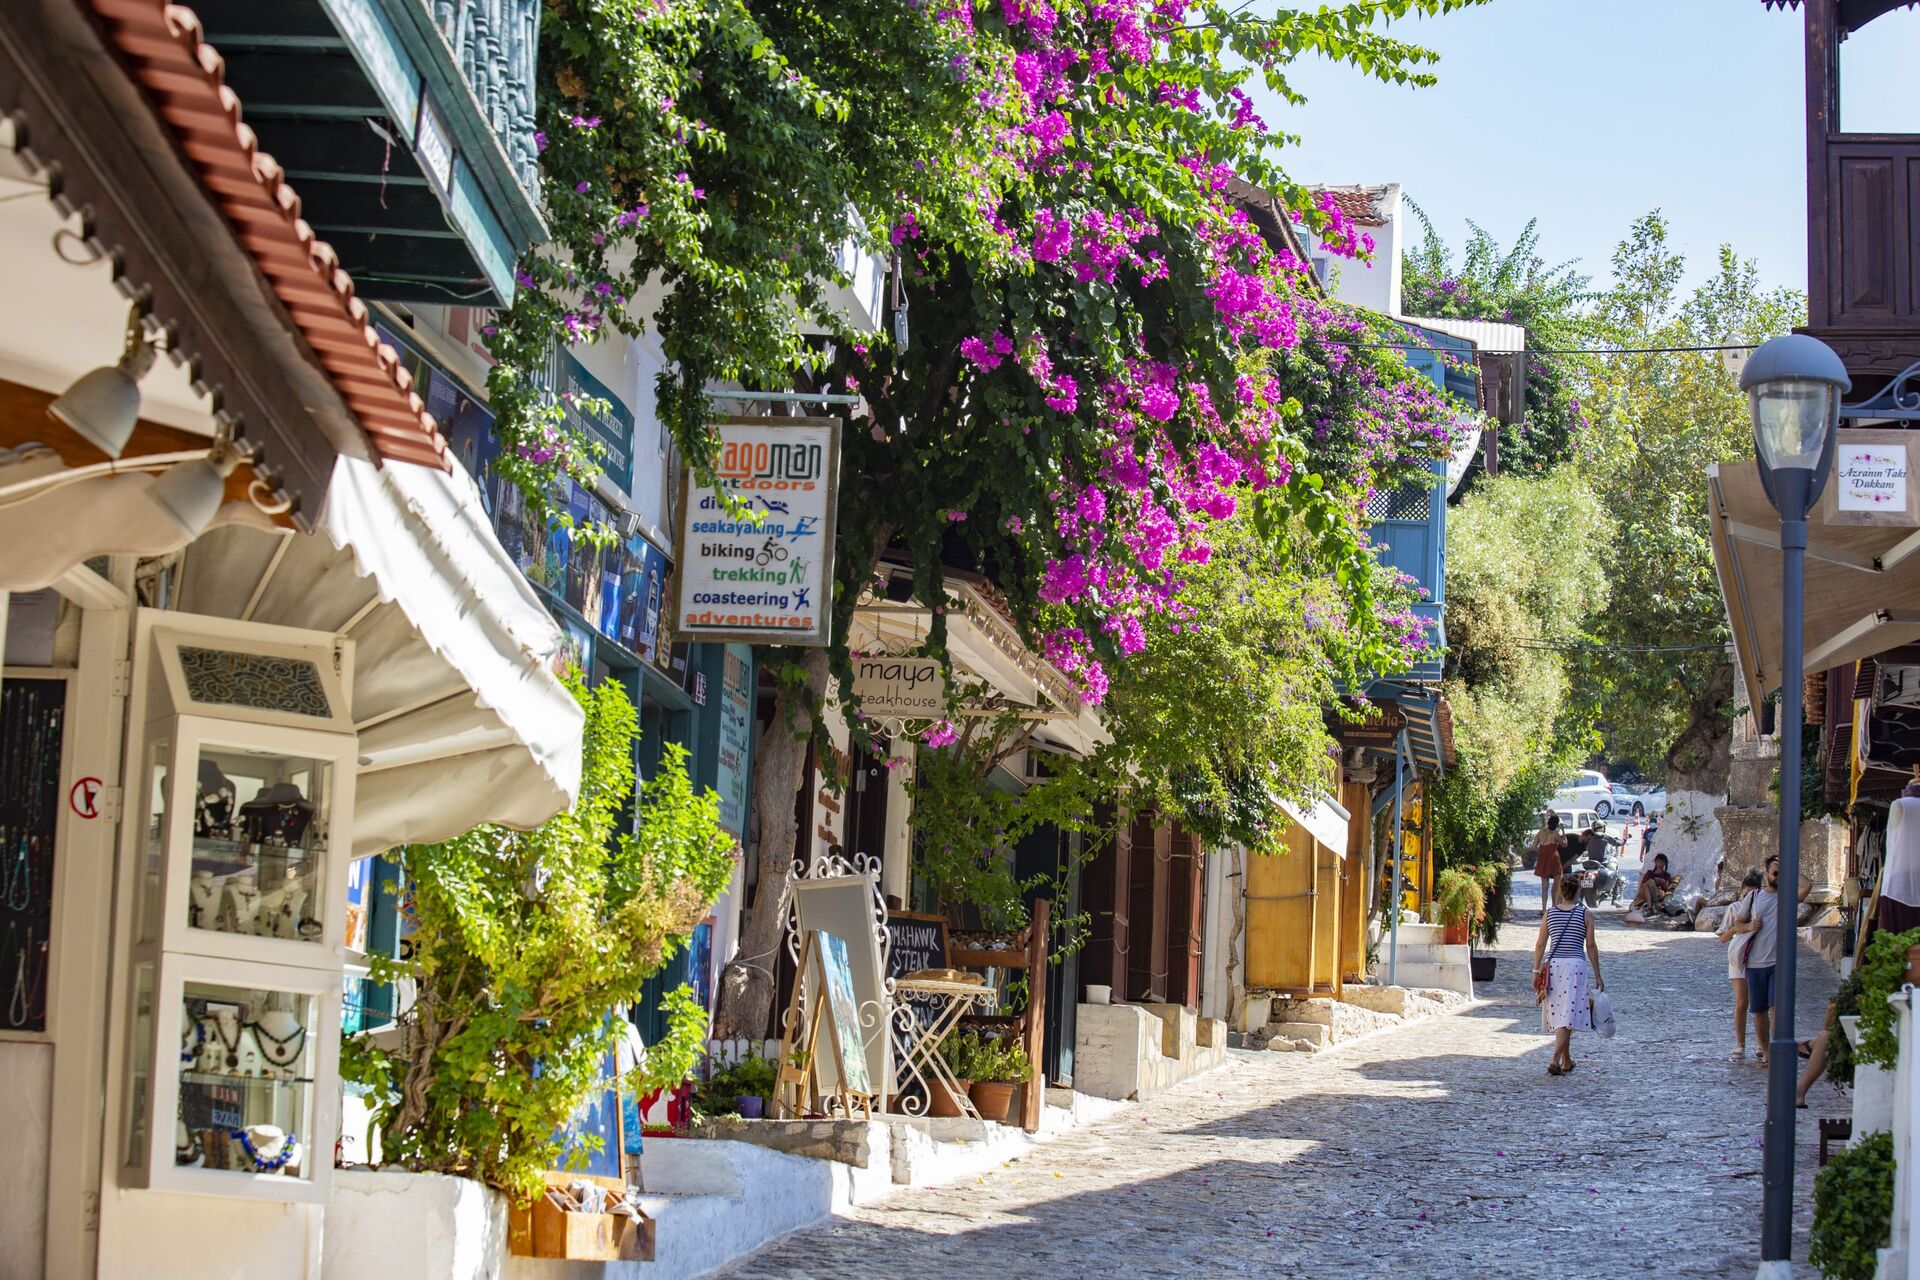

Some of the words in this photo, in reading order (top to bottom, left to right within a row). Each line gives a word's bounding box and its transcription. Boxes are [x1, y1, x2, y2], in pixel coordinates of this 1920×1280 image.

[721, 476, 816, 492] tdoors
[692, 519, 785, 538] seakayaking
[701, 543, 755, 561] biking
[712, 567, 787, 586] trekking
[693, 591, 789, 609] coasteering
[685, 611, 813, 627] adventures
[859, 662, 935, 690] maya
[859, 684, 937, 708] teakhouse
[888, 925, 940, 951] OMAHAWK
[892, 948, 930, 971] STEAK
